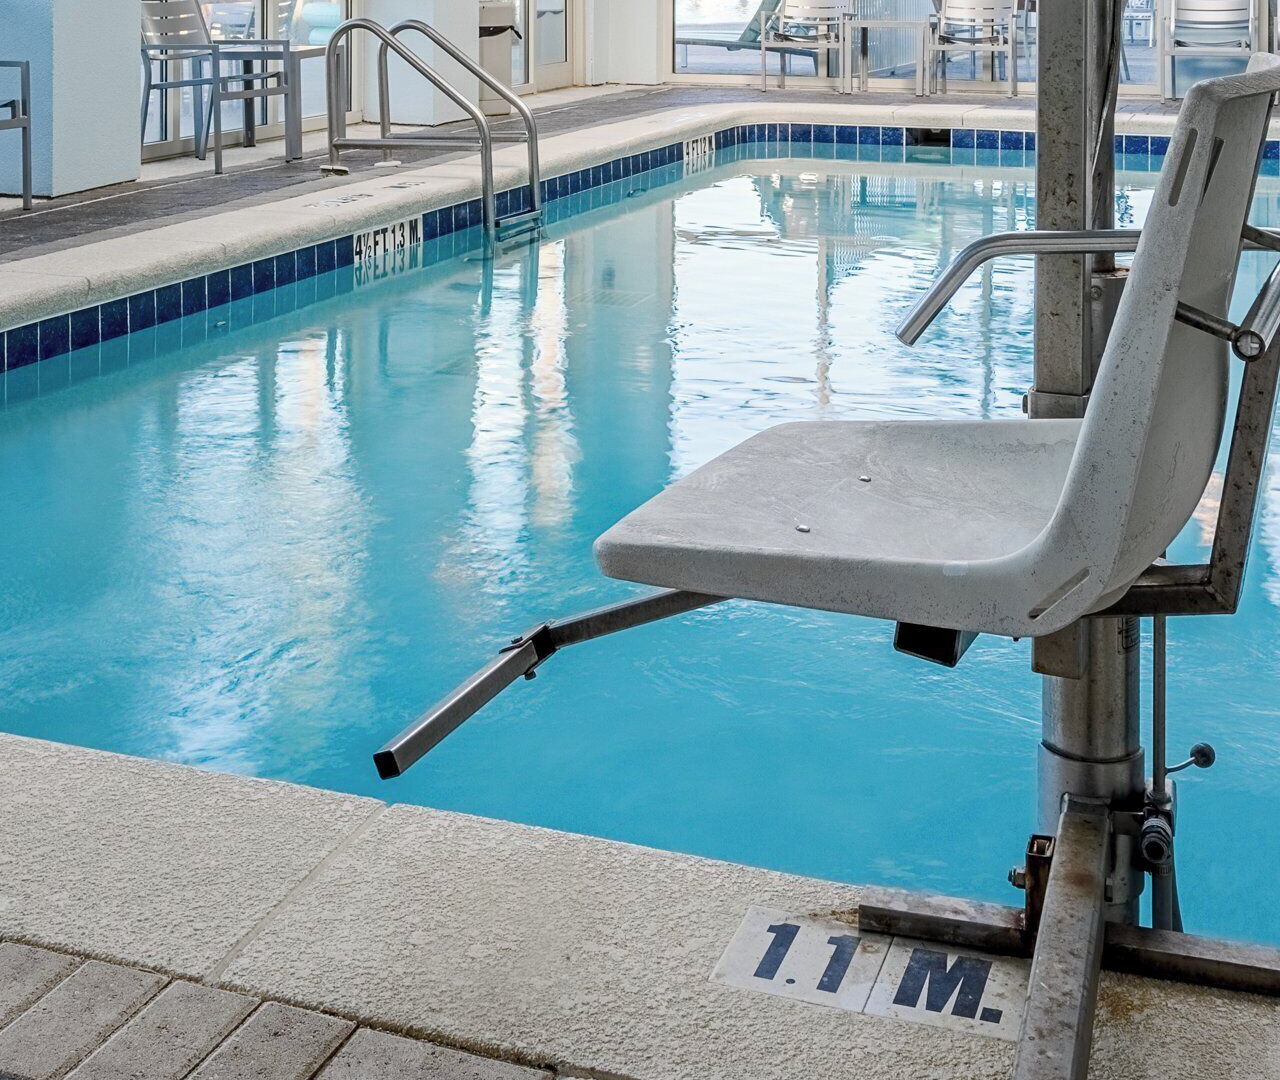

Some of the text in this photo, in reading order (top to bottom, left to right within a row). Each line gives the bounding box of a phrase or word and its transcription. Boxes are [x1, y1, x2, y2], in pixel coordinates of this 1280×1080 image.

[373, 226, 389, 256] FT.
[391, 222, 406, 251] 1.3
[409, 218, 421, 246] M.
[752, 922, 1004, 1024] 1.1 M.
